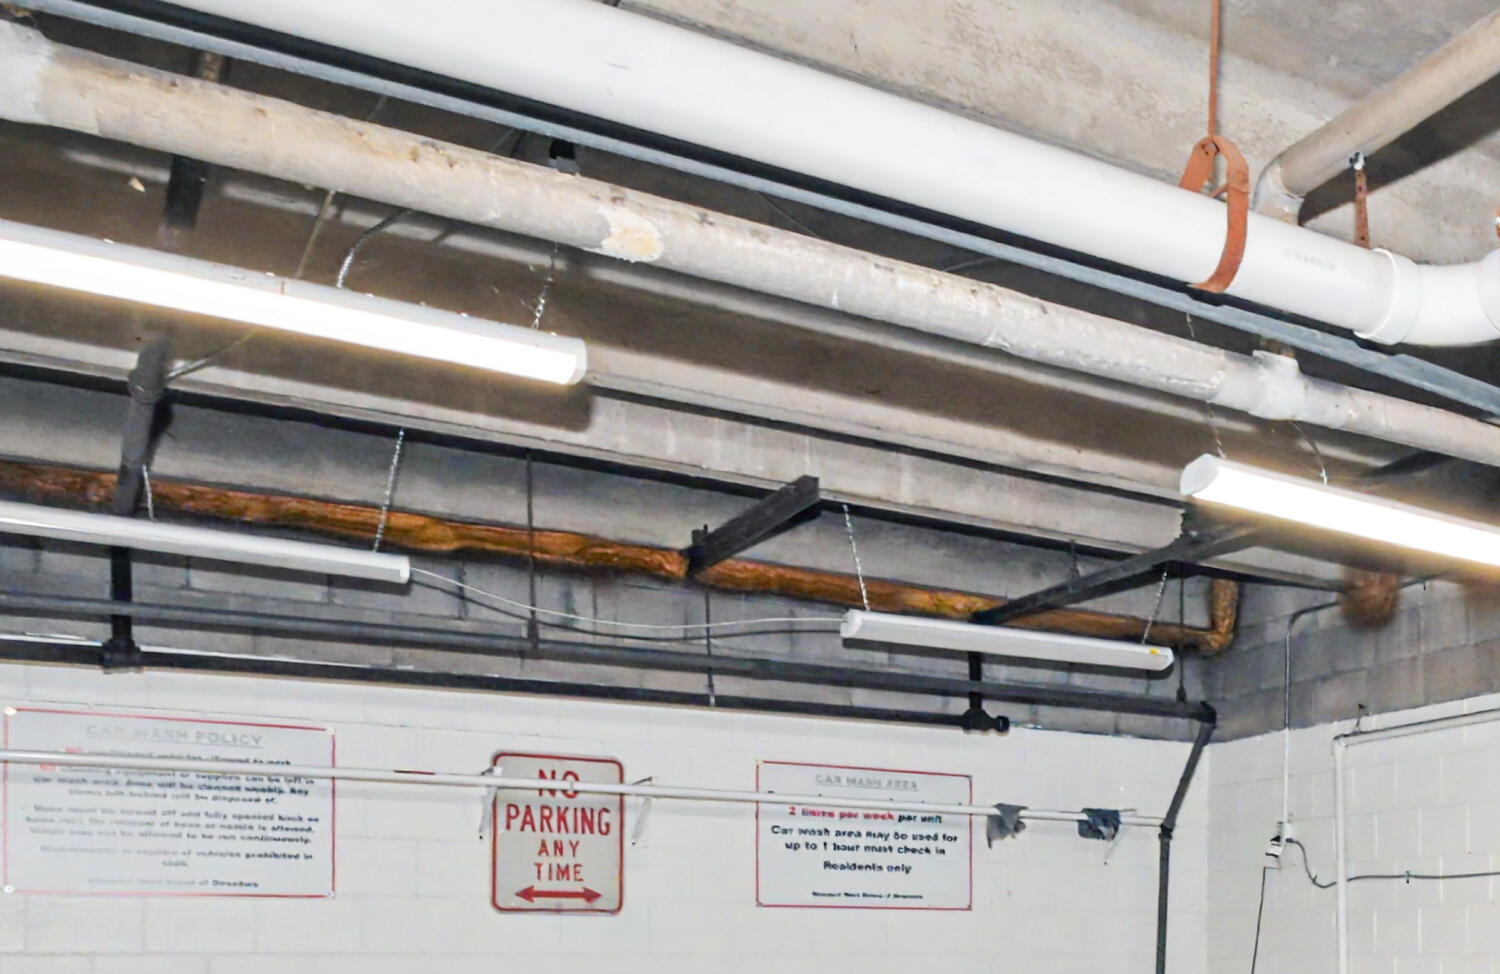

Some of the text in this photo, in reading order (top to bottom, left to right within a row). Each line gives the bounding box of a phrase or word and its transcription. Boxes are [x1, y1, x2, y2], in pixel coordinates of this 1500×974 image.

[196, 731, 263, 745] POLICY
[539, 768, 580, 799] NO
[815, 774, 842, 785] CAR
[506, 803, 611, 836] PARKING
[789, 806, 796, 816] 2
[839, 810, 859, 821] per
[897, 813, 917, 824] per
[921, 814, 943, 824] unit
[770, 825, 958, 843] Car wash area may be used for
[538, 839, 580, 857] ANY
[785, 842, 801, 852] up
[805, 841, 817, 850] to
[832, 842, 860, 852] hour
[864, 844, 893, 854] must
[897, 844, 932, 855] check
[935, 846, 946, 855] in
[534, 862, 584, 882] TIME
[823, 860, 912, 874] Residents only
